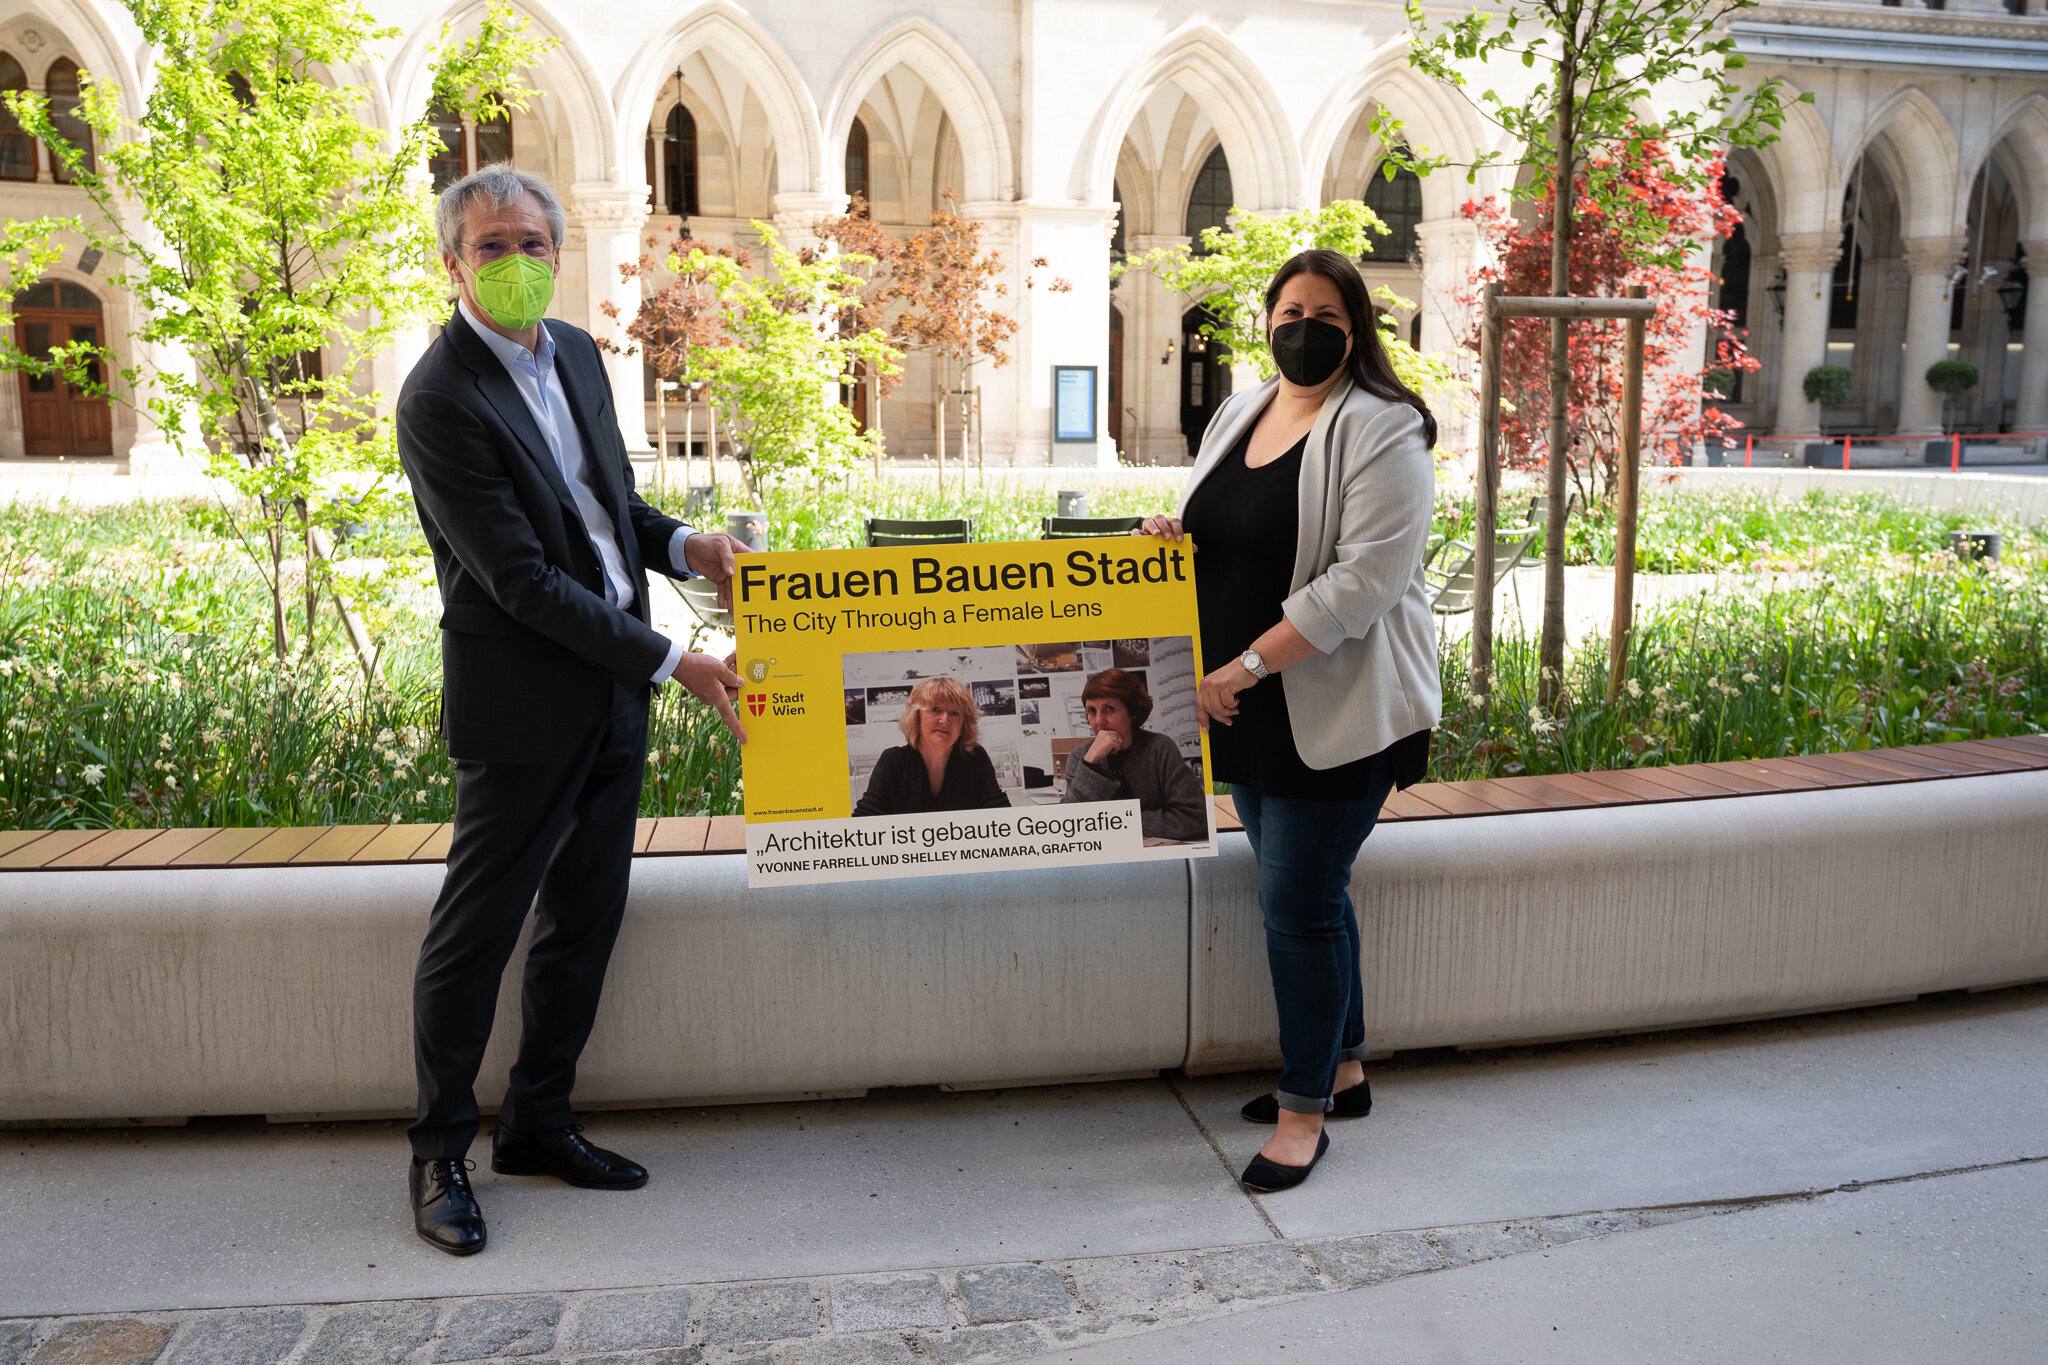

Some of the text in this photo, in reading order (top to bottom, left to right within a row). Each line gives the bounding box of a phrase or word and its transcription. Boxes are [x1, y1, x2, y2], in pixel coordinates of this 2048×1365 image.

[740, 547, 1186, 602] Frauen Bauen Stadt
[742, 600, 1103, 635] The City Through a Female Lens
[772, 692, 805, 704] Stadt
[772, 705, 806, 716] Wien
[753, 806, 824, 816] www.frauenbauenstadt.at
[756, 829, 886, 857] „Architektur
[891, 825, 916, 845] ist
[921, 819, 1011, 848] gebaute
[756, 841, 1102, 874] YVONNE FARRELL UND SHELLEY MCNAMARA, GRAFTON
